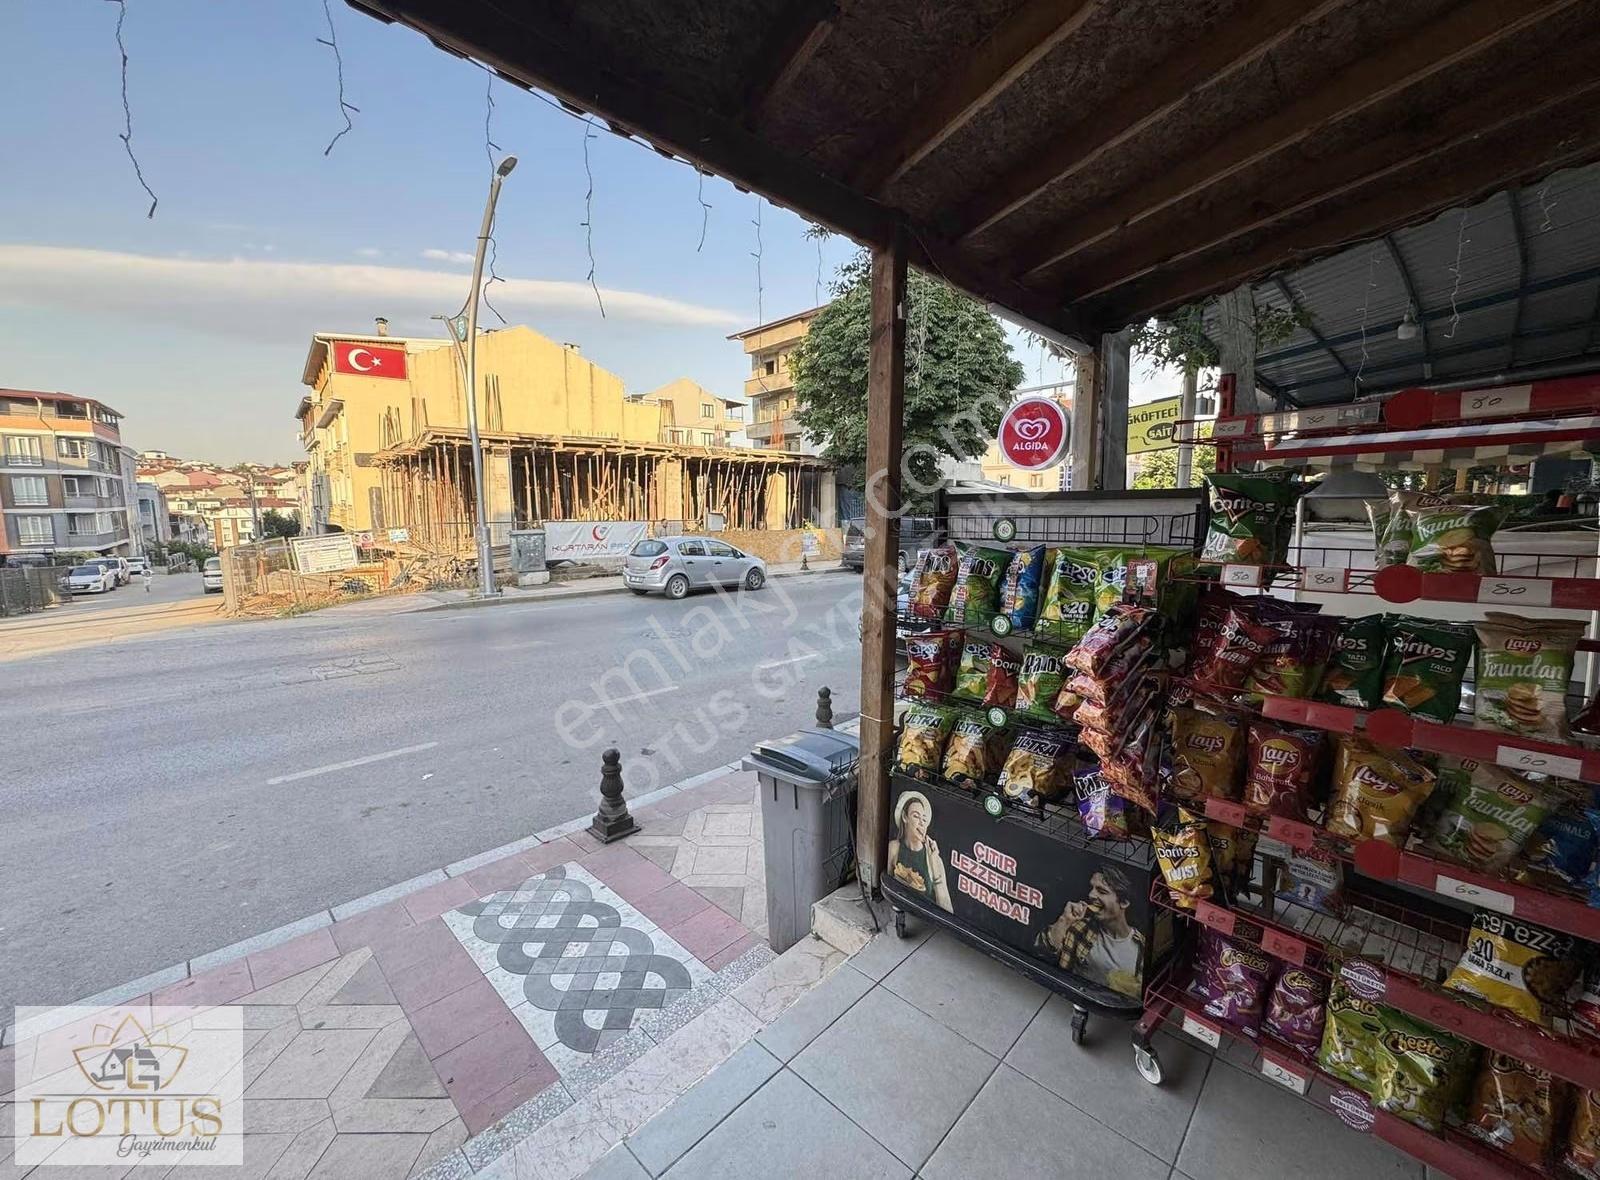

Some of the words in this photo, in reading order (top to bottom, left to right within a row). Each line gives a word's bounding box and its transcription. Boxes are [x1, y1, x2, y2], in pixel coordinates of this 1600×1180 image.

[1013, 441, 1049, 452] ALGIDA
[1219, 624, 1265, 654] Doritos
[1014, 736, 1061, 758] ULTRA
[1261, 745, 1299, 766] Lay's
[1519, 754, 1548, 767] 60
[973, 841, 1017, 877] ÇITIR
[1157, 845, 1200, 860] Doritos
[951, 849, 1043, 910] LEZZETLER
[1167, 862, 1200, 883] TWIST
[958, 873, 1030, 926] BURADA!
[1455, 884, 1480, 896] 60
[1207, 911, 1226, 923] 60
[1384, 1030, 1453, 1062] Cheetos
